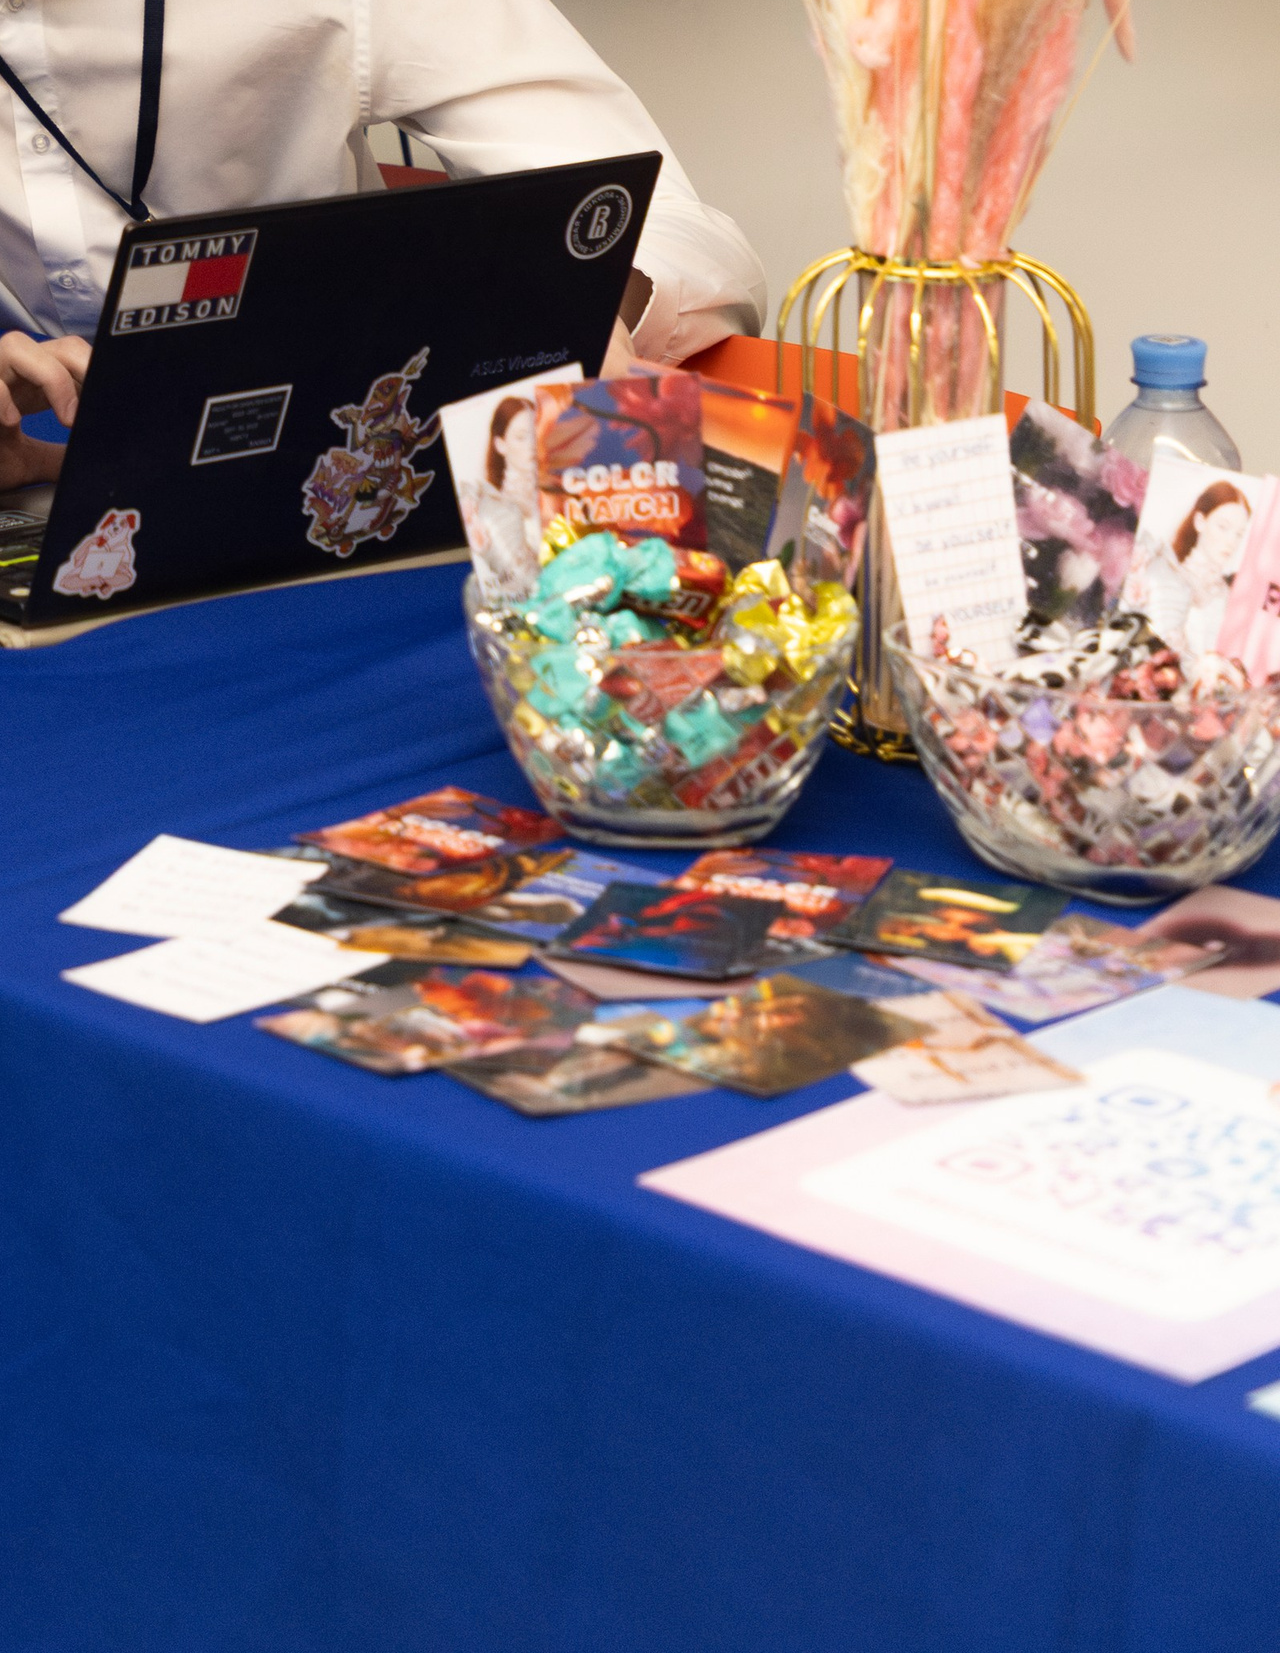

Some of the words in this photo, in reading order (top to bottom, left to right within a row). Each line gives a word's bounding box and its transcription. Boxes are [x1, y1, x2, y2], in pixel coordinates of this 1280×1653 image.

[142, 235, 246, 266] TOMMY
[119, 297, 235, 330] EDISON
[469, 357, 507, 378] ASUS
[507, 346, 570, 372] VivoBook
[562, 459, 680, 494] COLOR
[563, 491, 681, 527] MATCH
